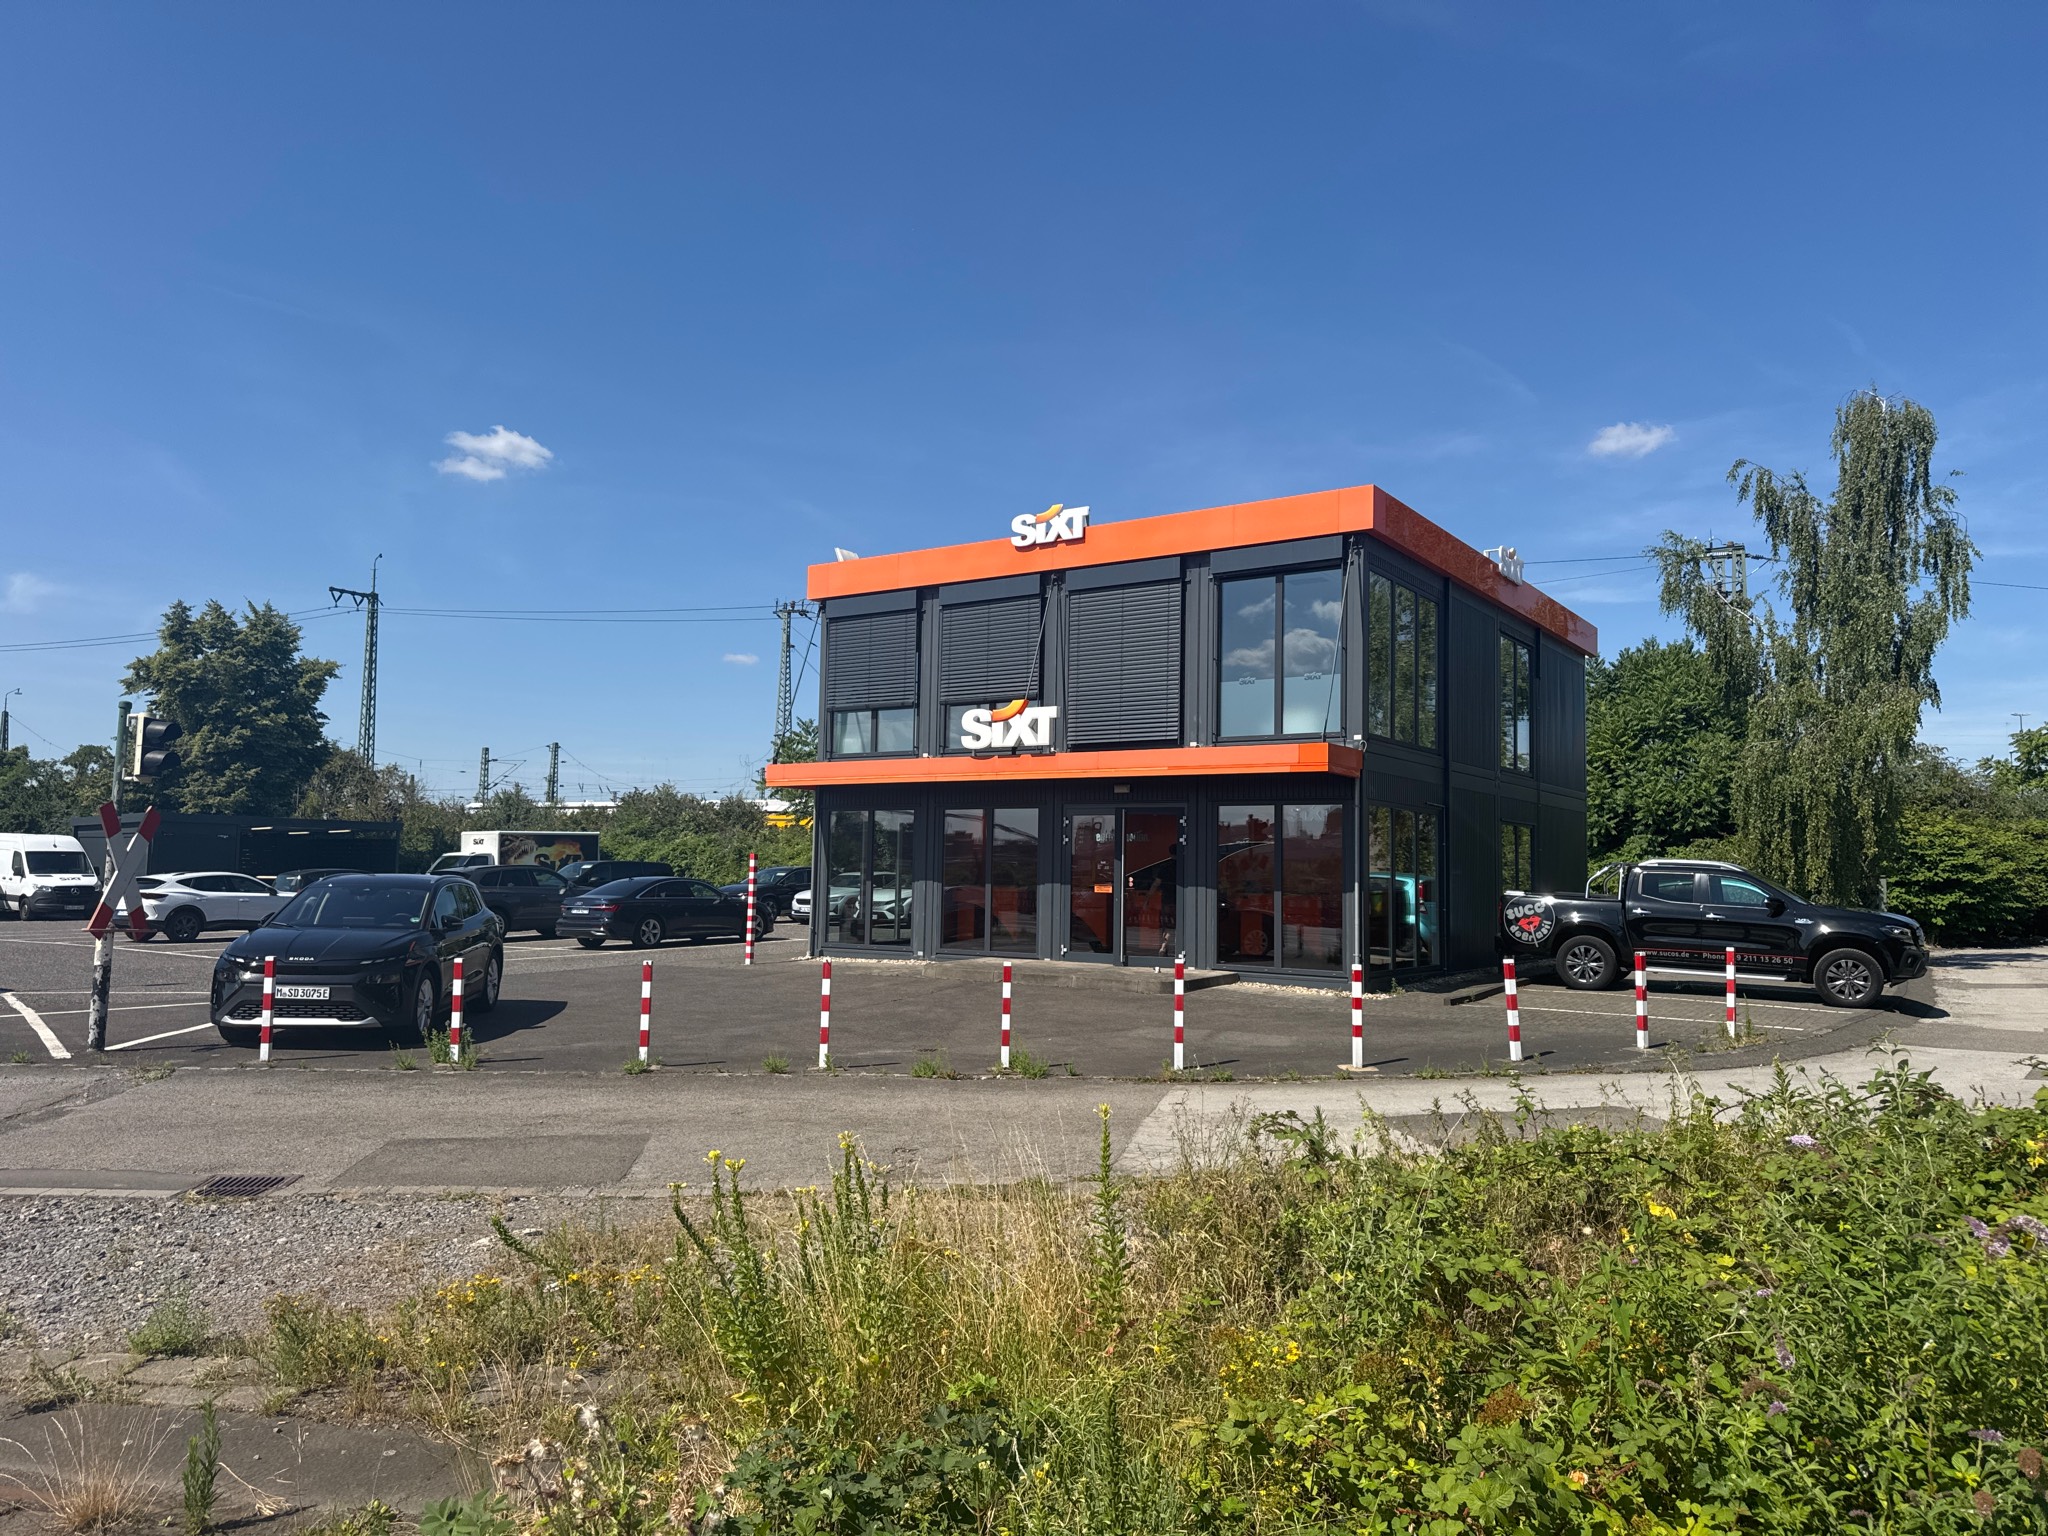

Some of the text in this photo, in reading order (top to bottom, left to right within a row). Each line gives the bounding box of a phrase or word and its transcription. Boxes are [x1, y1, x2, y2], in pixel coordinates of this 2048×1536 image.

[1702, 952, 1725, 960] Phone
[1743, 955, 1758, 963] 211
[1760, 955, 1770, 963] 13
[1772, 956, 1782, 964] 26
[1783, 957, 1794, 965] 50
